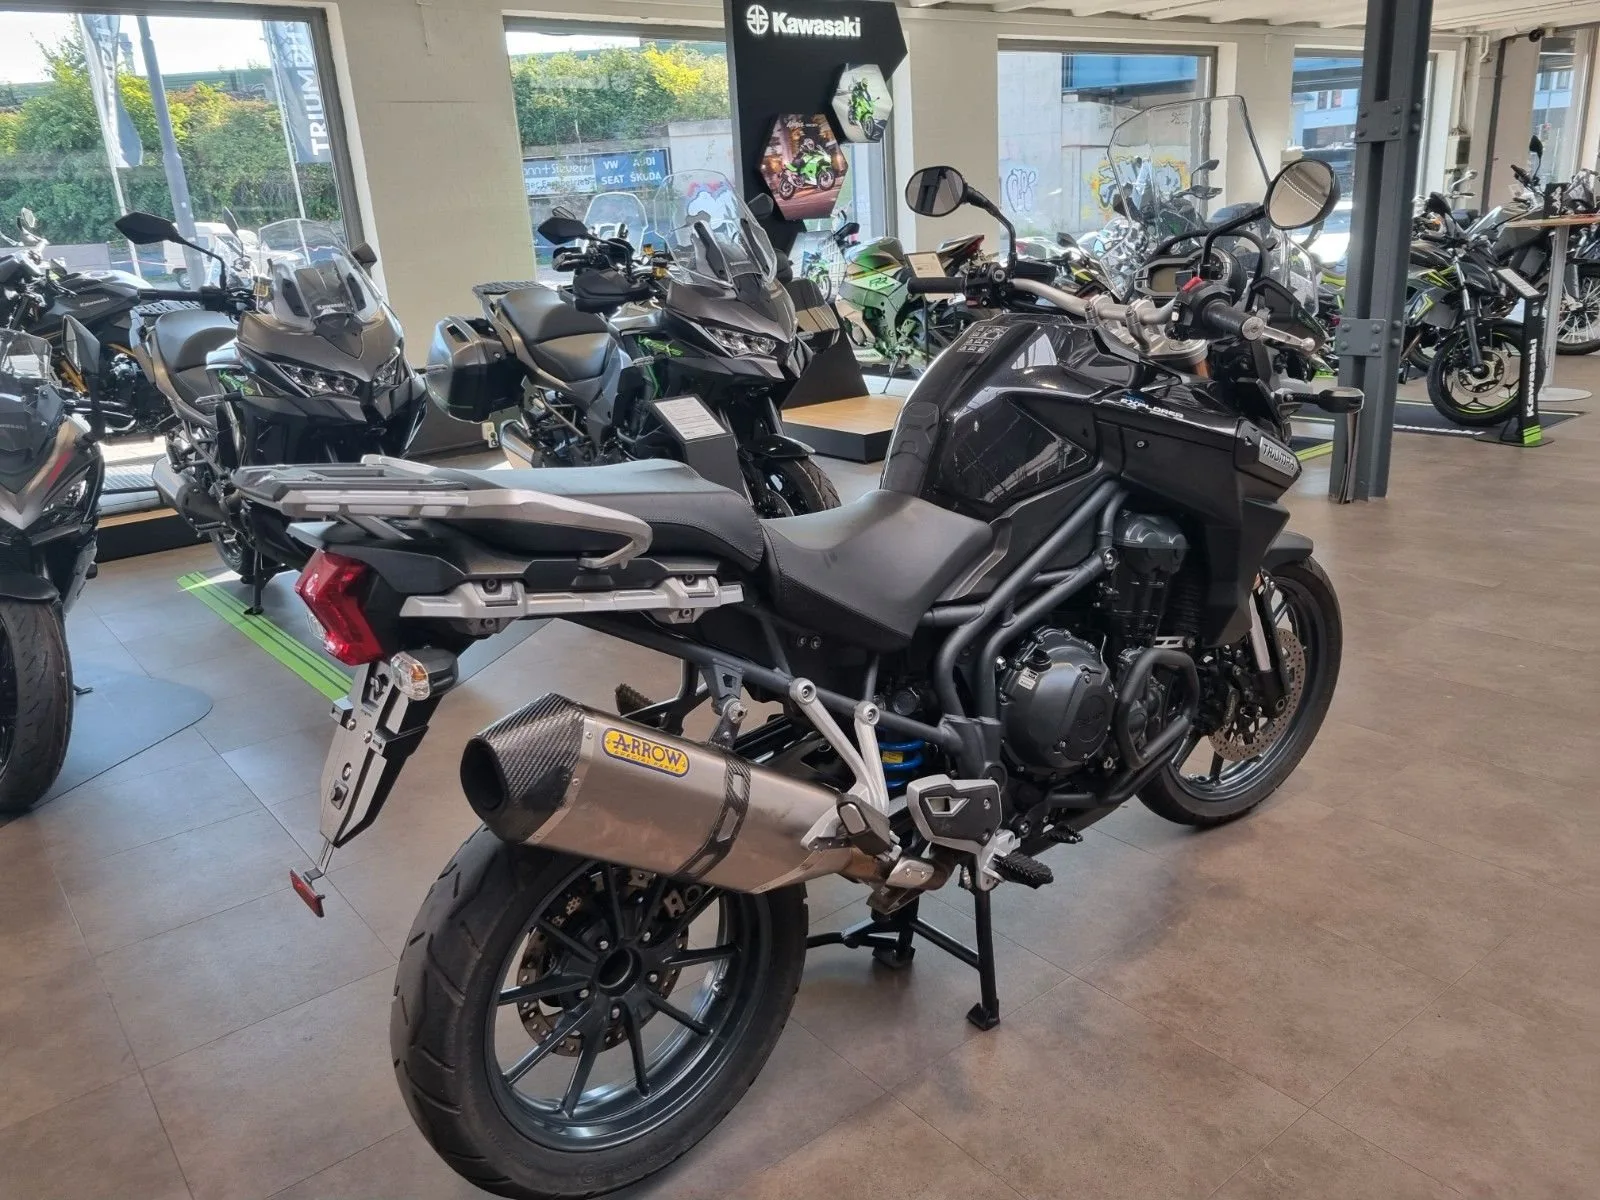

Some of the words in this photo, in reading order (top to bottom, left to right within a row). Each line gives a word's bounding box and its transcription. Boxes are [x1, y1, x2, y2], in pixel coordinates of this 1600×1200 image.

[772, 11, 861, 37] Kawasaki
[287, 32, 330, 156] TRIUMPH
[603, 160, 619, 170] VW
[601, 174, 625, 186] SEAT
[1526, 338, 1538, 417] Kawasaki
[1121, 398, 1184, 419] EXPLORER
[613, 733, 682, 767] ARROW
